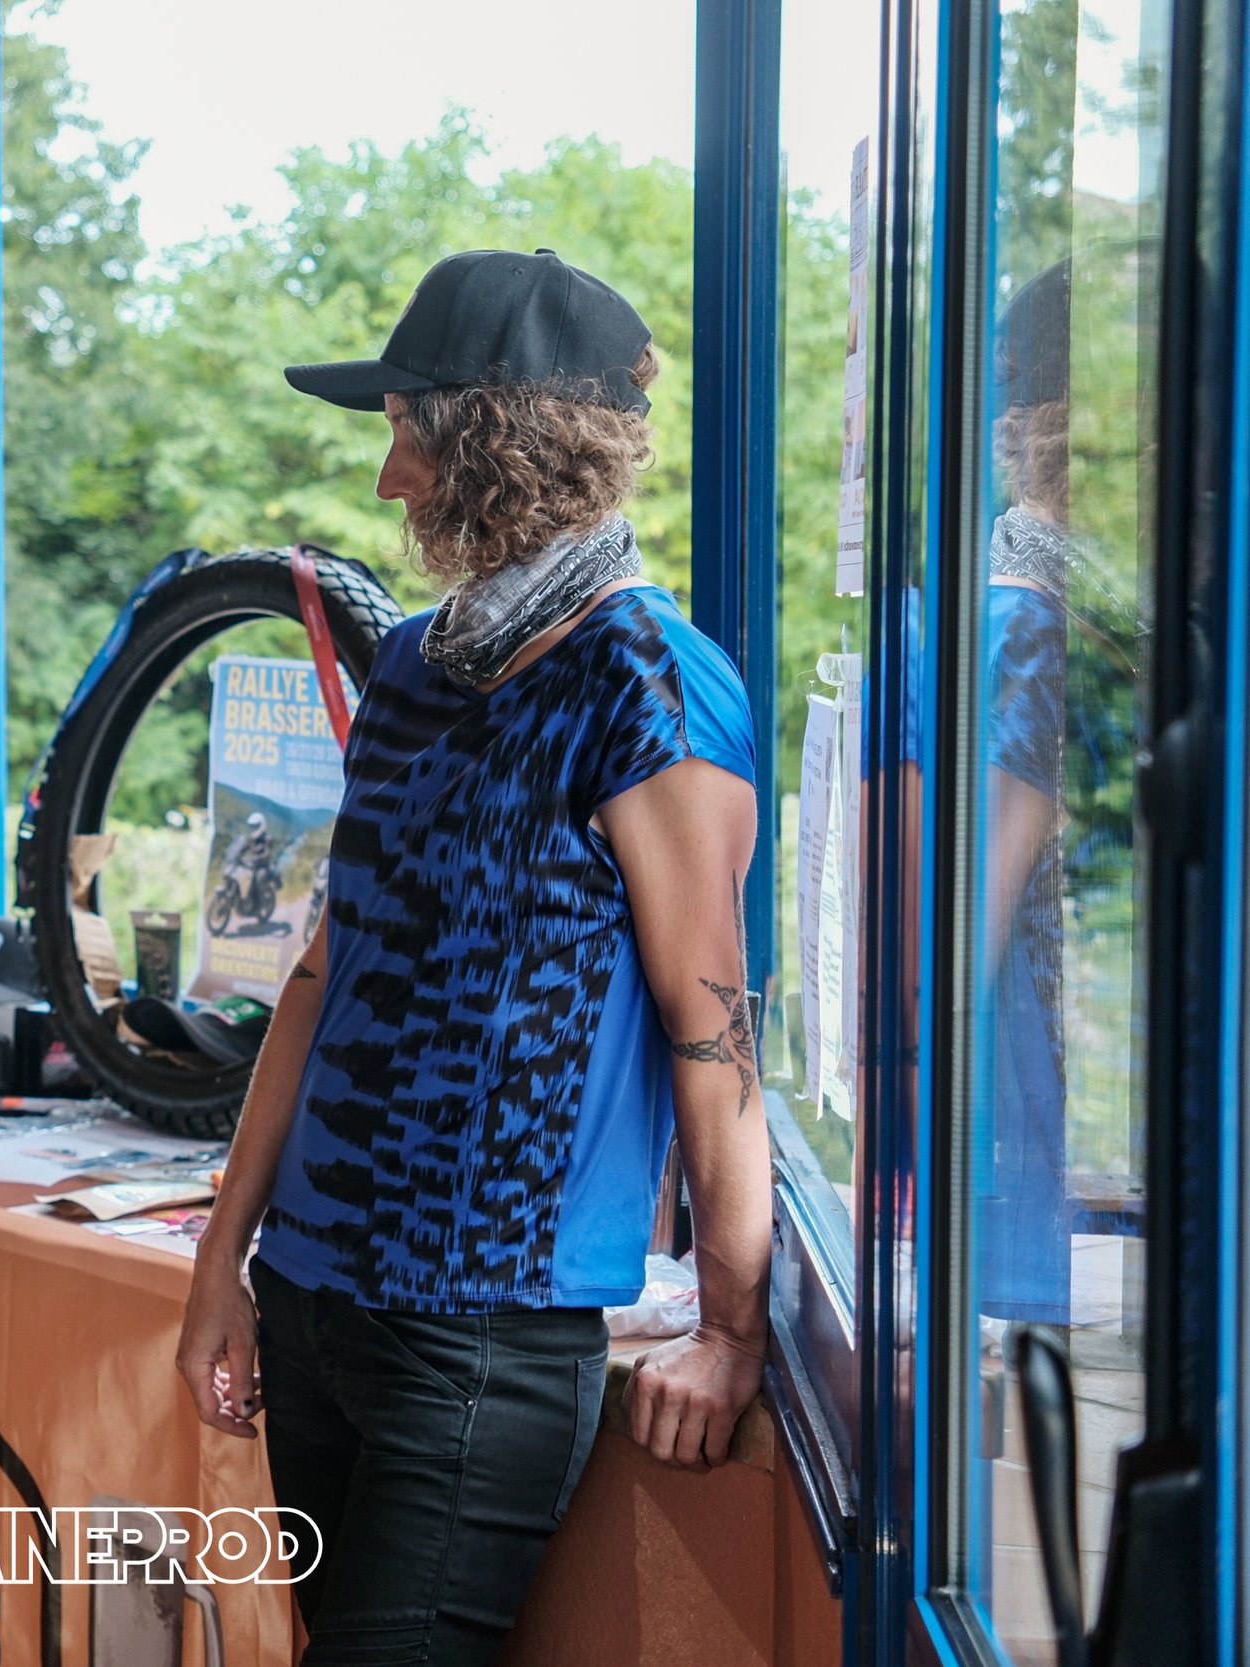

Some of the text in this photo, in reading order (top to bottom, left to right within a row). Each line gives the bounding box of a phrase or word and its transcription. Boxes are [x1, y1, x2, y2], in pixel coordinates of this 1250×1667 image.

[227, 665, 309, 702] RALLYE
[224, 699, 336, 739] BRASSER
[224, 732, 280, 766] 2025
